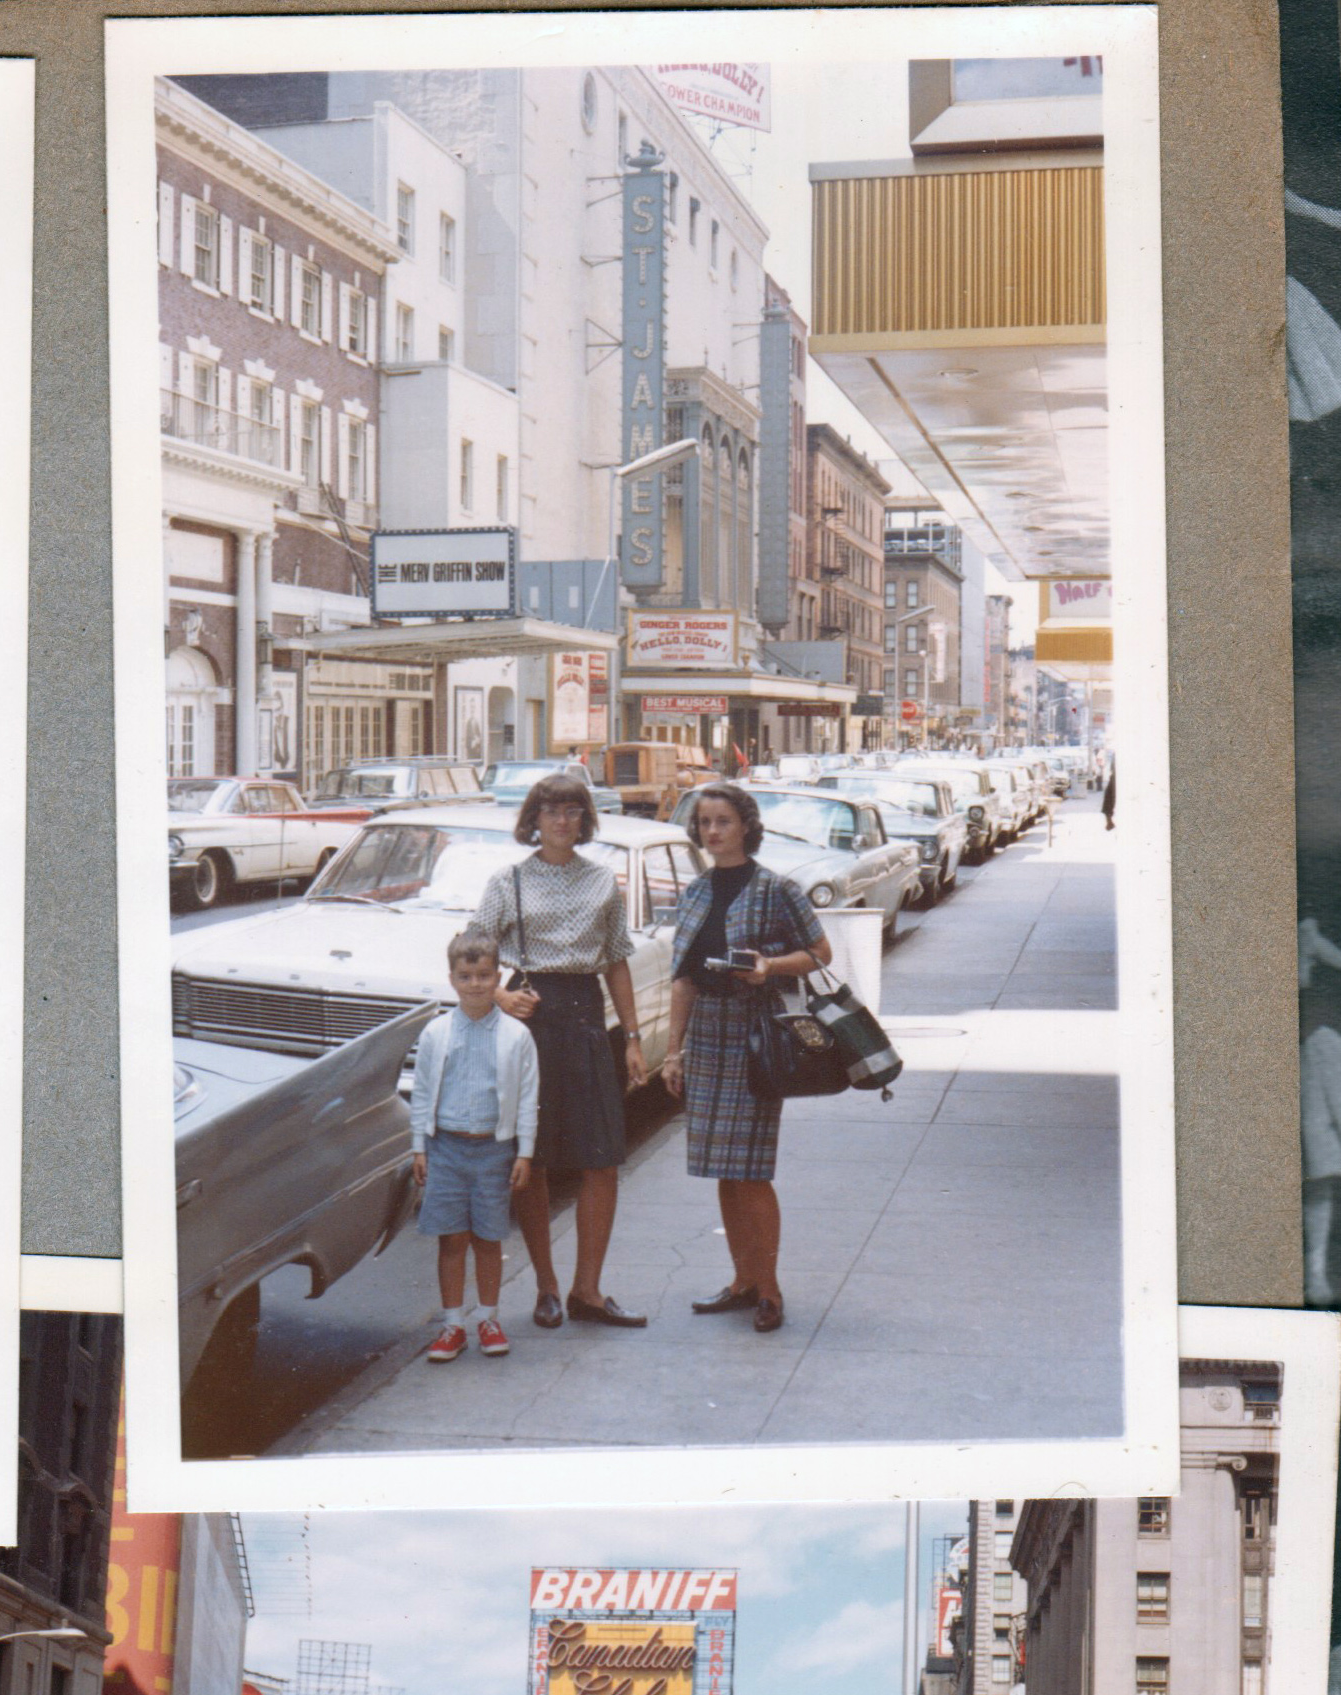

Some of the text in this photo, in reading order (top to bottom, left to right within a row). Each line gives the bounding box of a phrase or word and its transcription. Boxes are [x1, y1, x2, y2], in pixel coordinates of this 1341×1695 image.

[703, 94, 761, 122] CHAMPION
[630, 318, 655, 566] JAMES
[378, 561, 506, 584] THE MERV GRIFFIN SHOW
[639, 621, 727, 630] GINGER ROGERS
[646, 696, 722, 707] BEST MUSICAL
[532, 1571, 735, 1610] BRANIFF
[547, 1619, 696, 1670] Canadian
